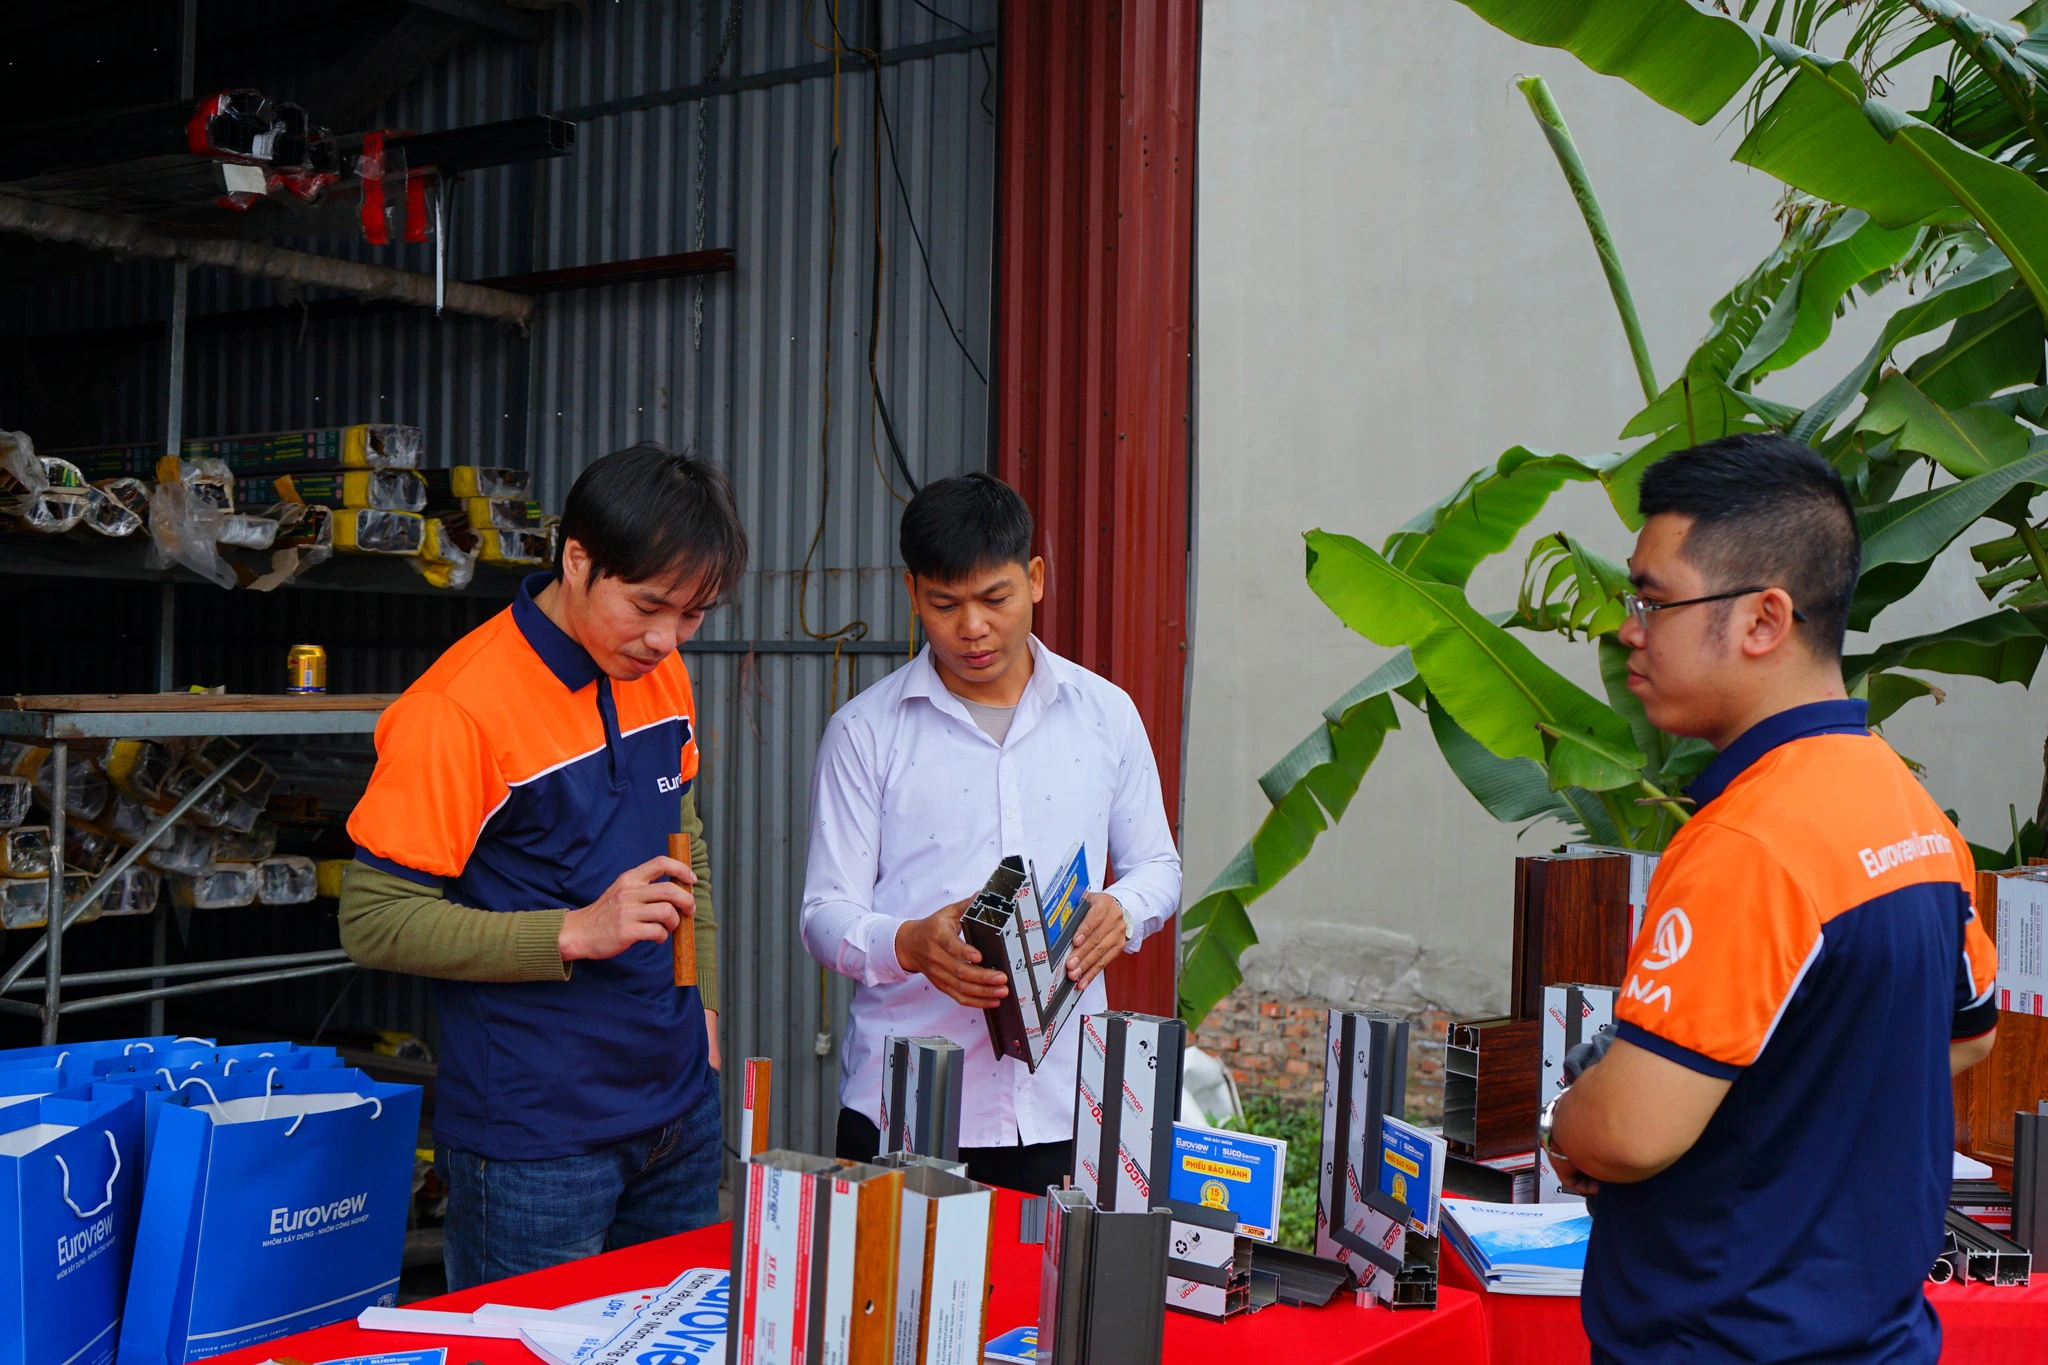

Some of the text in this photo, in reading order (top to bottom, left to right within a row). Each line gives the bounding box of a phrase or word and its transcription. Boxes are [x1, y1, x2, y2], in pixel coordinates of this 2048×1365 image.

[1176, 1137, 1209, 1152] Euroview
[1185, 1158, 1248, 1179] PHIẾU BẢO HÀNH
[1210, 1187, 1220, 1197] 15
[269, 1192, 368, 1235] Euroview
[1471, 1205, 1543, 1217] Euroview
[57, 1212, 114, 1266] Euroview
[262, 1238, 282, 1247] NHÔM
[282, 1235, 296, 1244] XÂY
[318, 1226, 335, 1235] NHÔM
[1248, 1228, 1265, 1237] JOTUN
